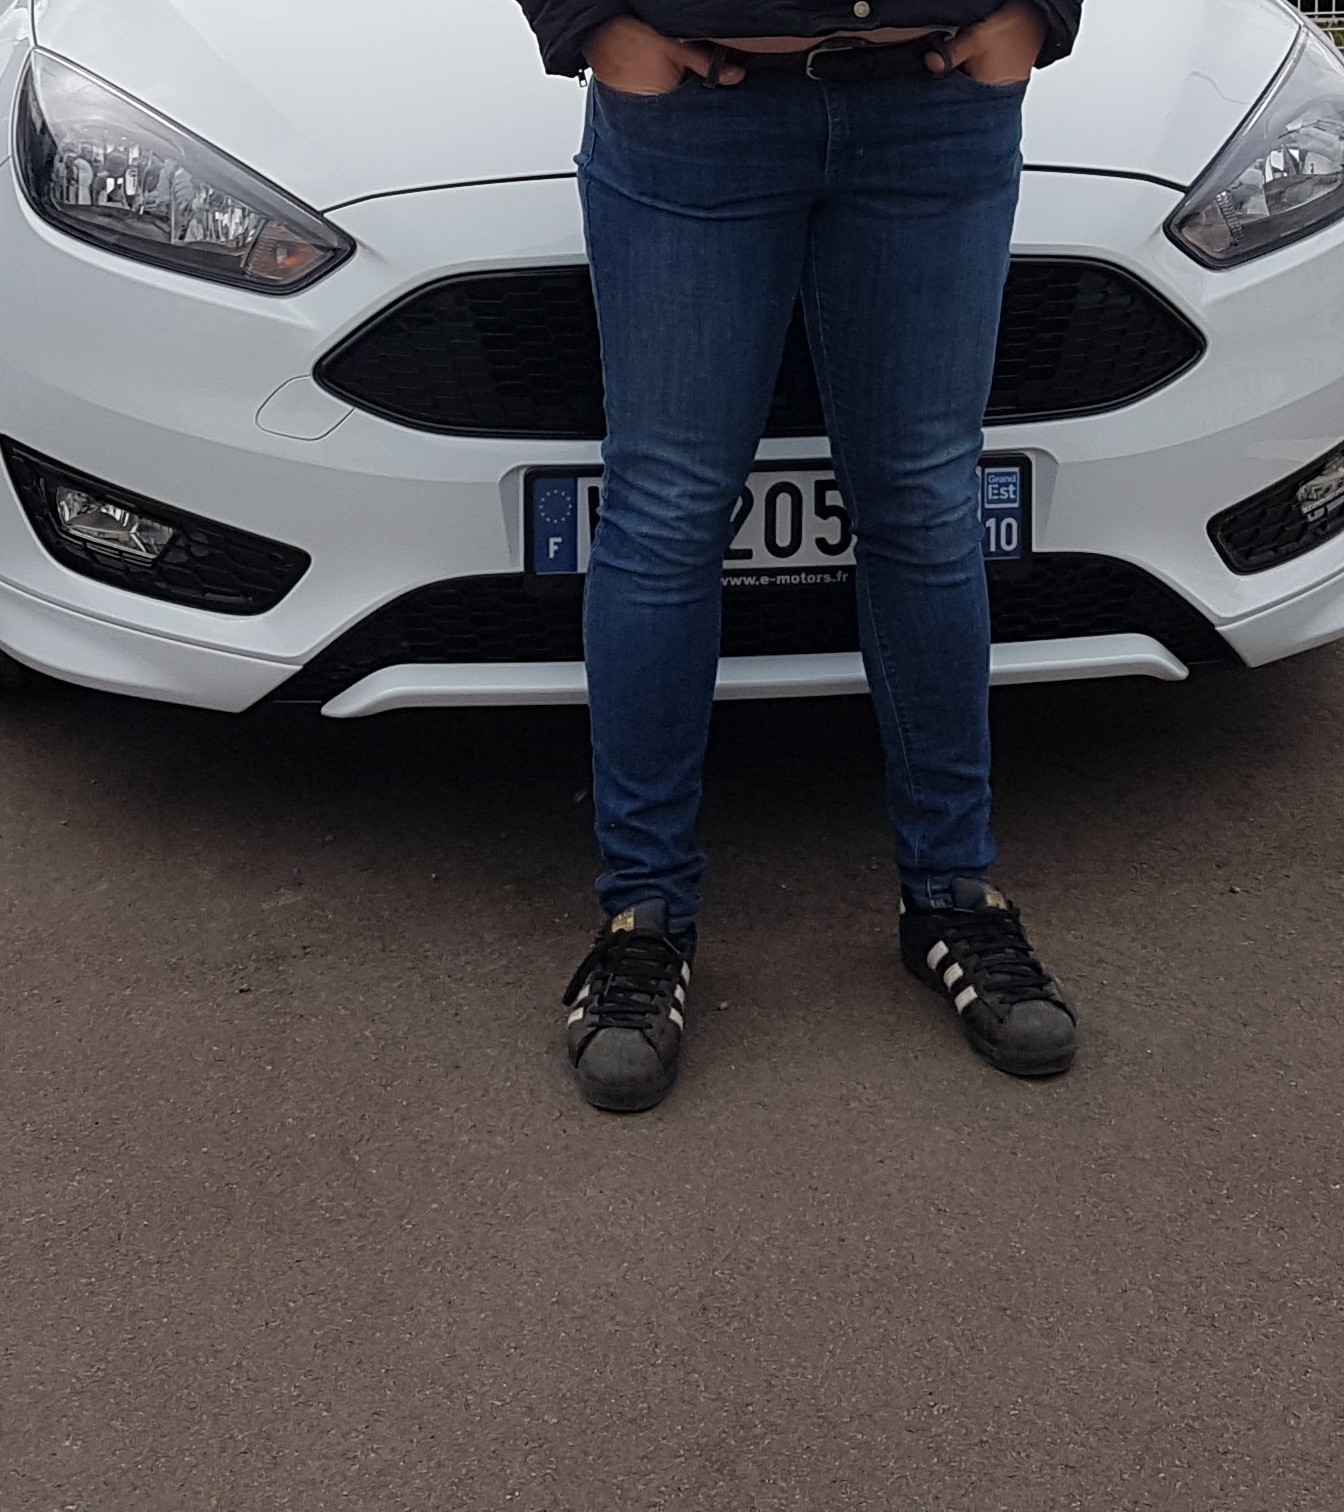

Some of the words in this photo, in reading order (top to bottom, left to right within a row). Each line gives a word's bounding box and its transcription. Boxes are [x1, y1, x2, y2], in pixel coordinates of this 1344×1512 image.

[987, 474, 1017, 483] Grand
[988, 483, 1016, 500] Est
[985, 517, 1018, 553] 10
[548, 537, 563, 559] F
[721, 570, 849, 586] www.e-motors.fr
